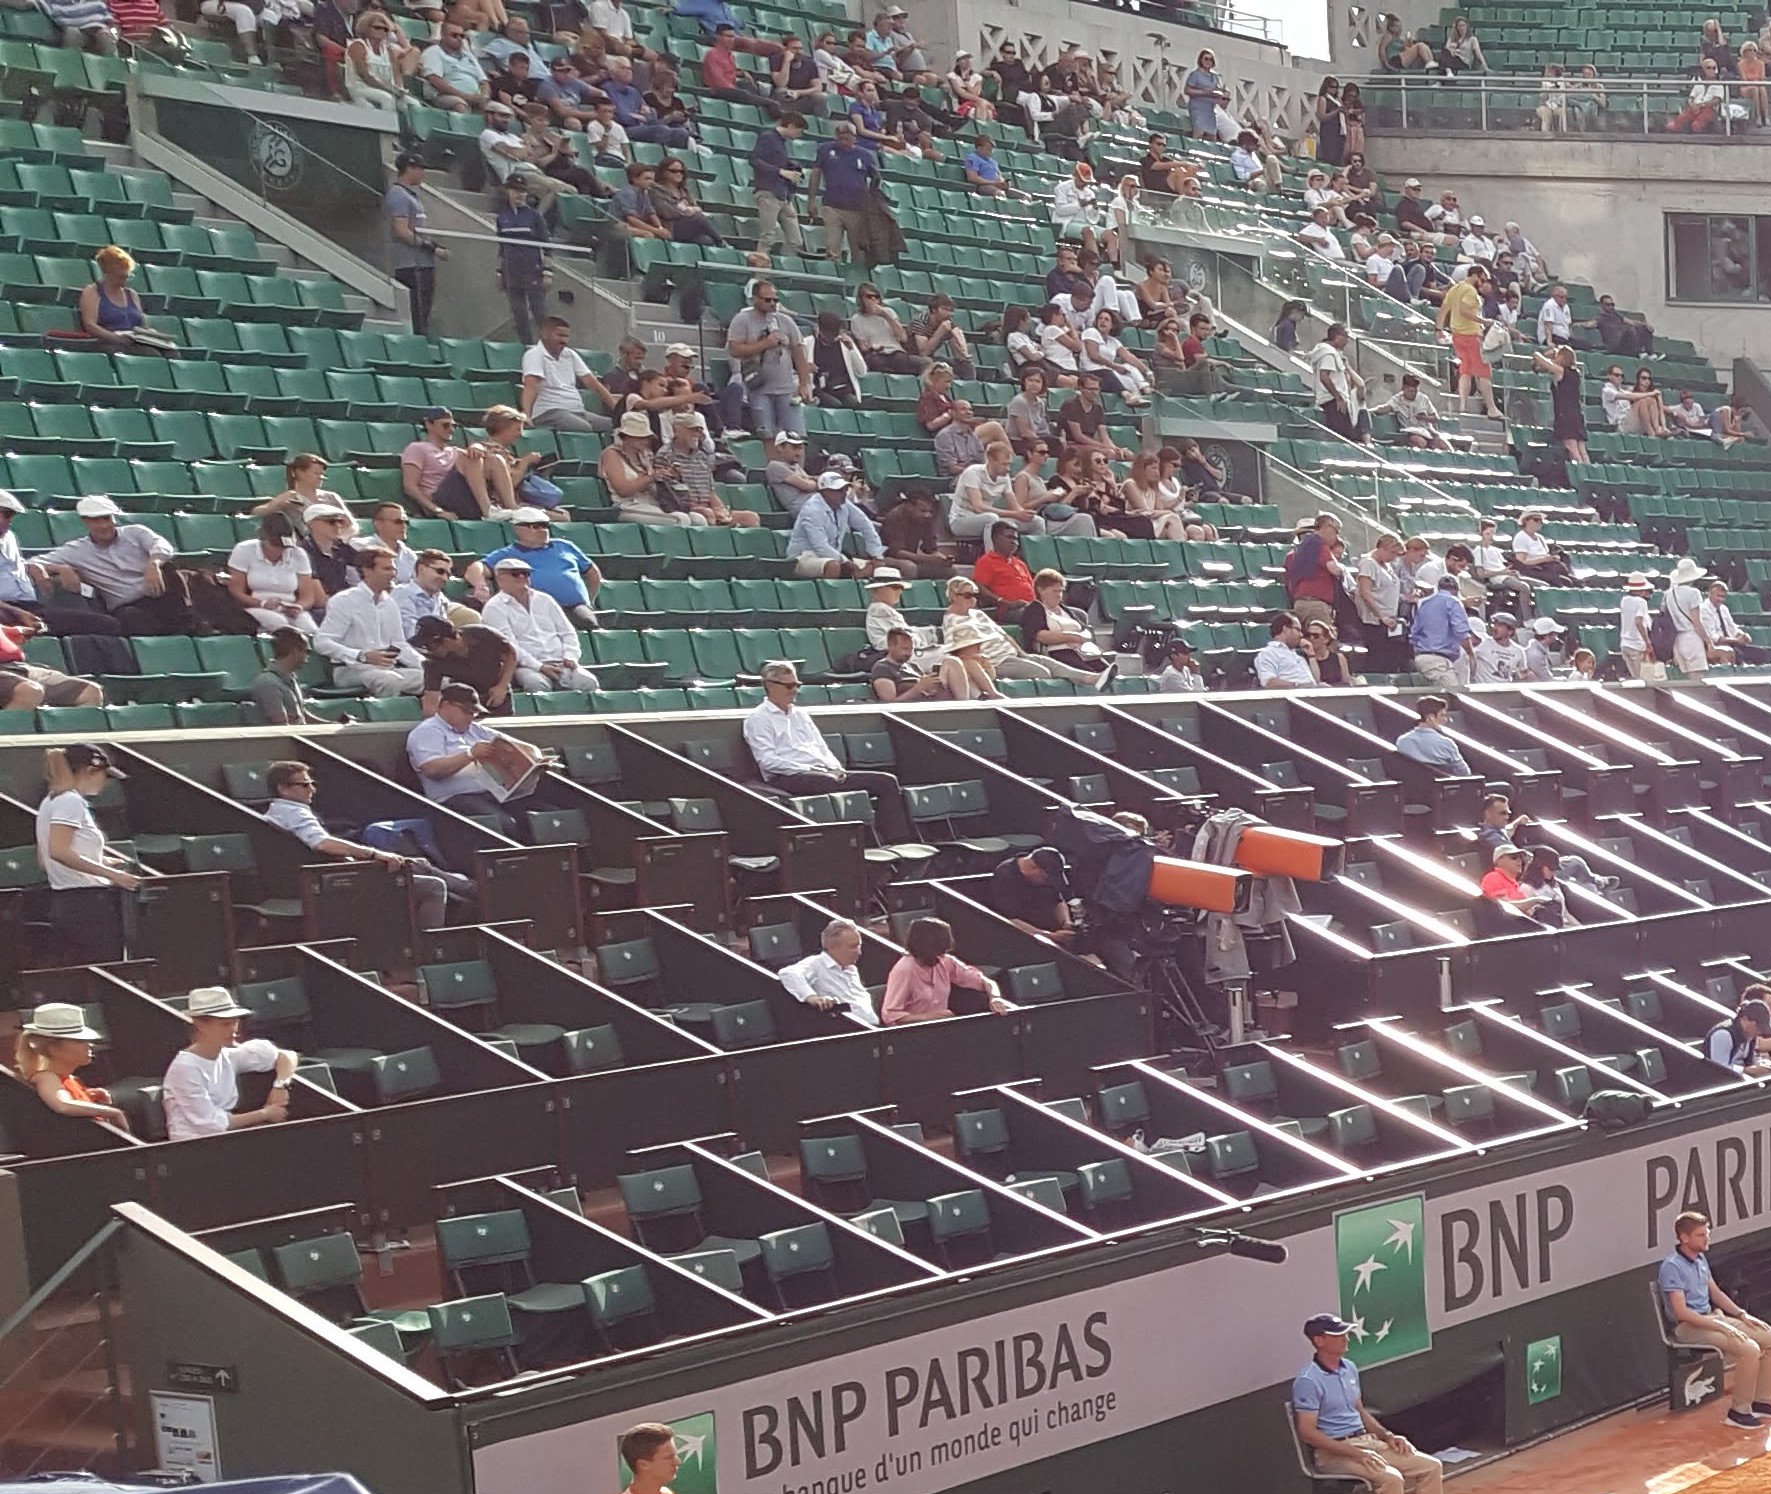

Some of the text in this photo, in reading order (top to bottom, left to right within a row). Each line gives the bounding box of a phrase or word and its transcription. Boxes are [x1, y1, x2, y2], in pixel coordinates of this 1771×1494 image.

[1440, 1183, 1576, 1312] BNP
[742, 1311, 1115, 1480] BNP PARIBAS
[874, 1449, 924, 1486] d'un
[929, 1424, 1004, 1471] monde
[1008, 1410, 1042, 1454] qui
[1045, 1387, 1118, 1437] change
